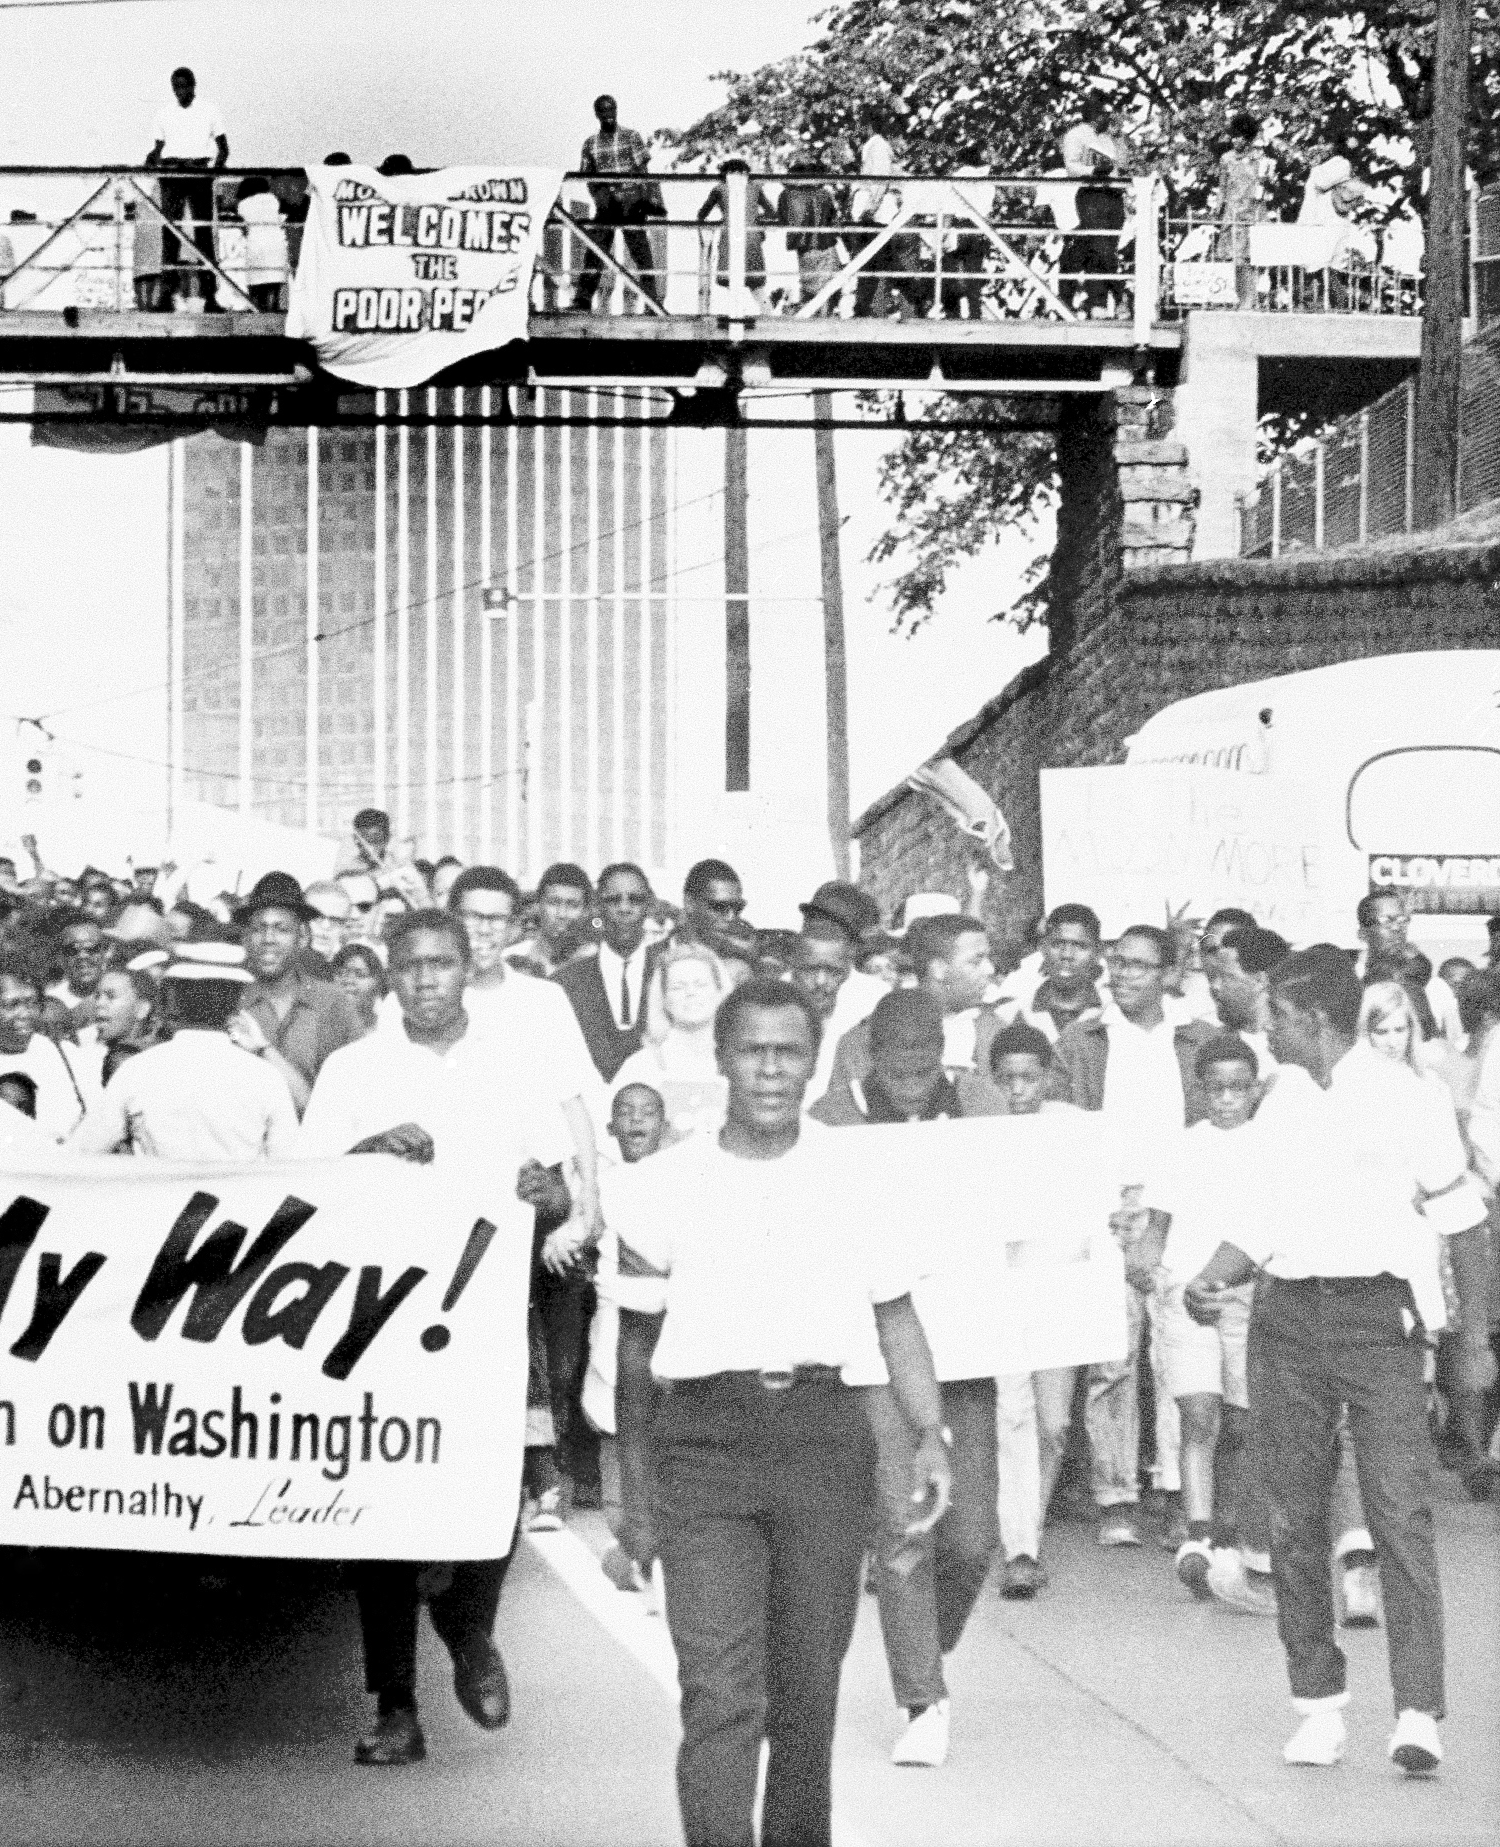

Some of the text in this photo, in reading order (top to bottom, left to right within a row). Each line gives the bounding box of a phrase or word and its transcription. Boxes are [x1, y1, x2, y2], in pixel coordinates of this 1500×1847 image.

[338, 204, 531, 252] WELCOMES
[411, 253, 458, 281] THE
[333, 287, 424, 334] POOR
[129, 1190, 498, 1382] Way!
[47, 1401, 107, 1451] on
[127, 1380, 442, 1483] Washington
